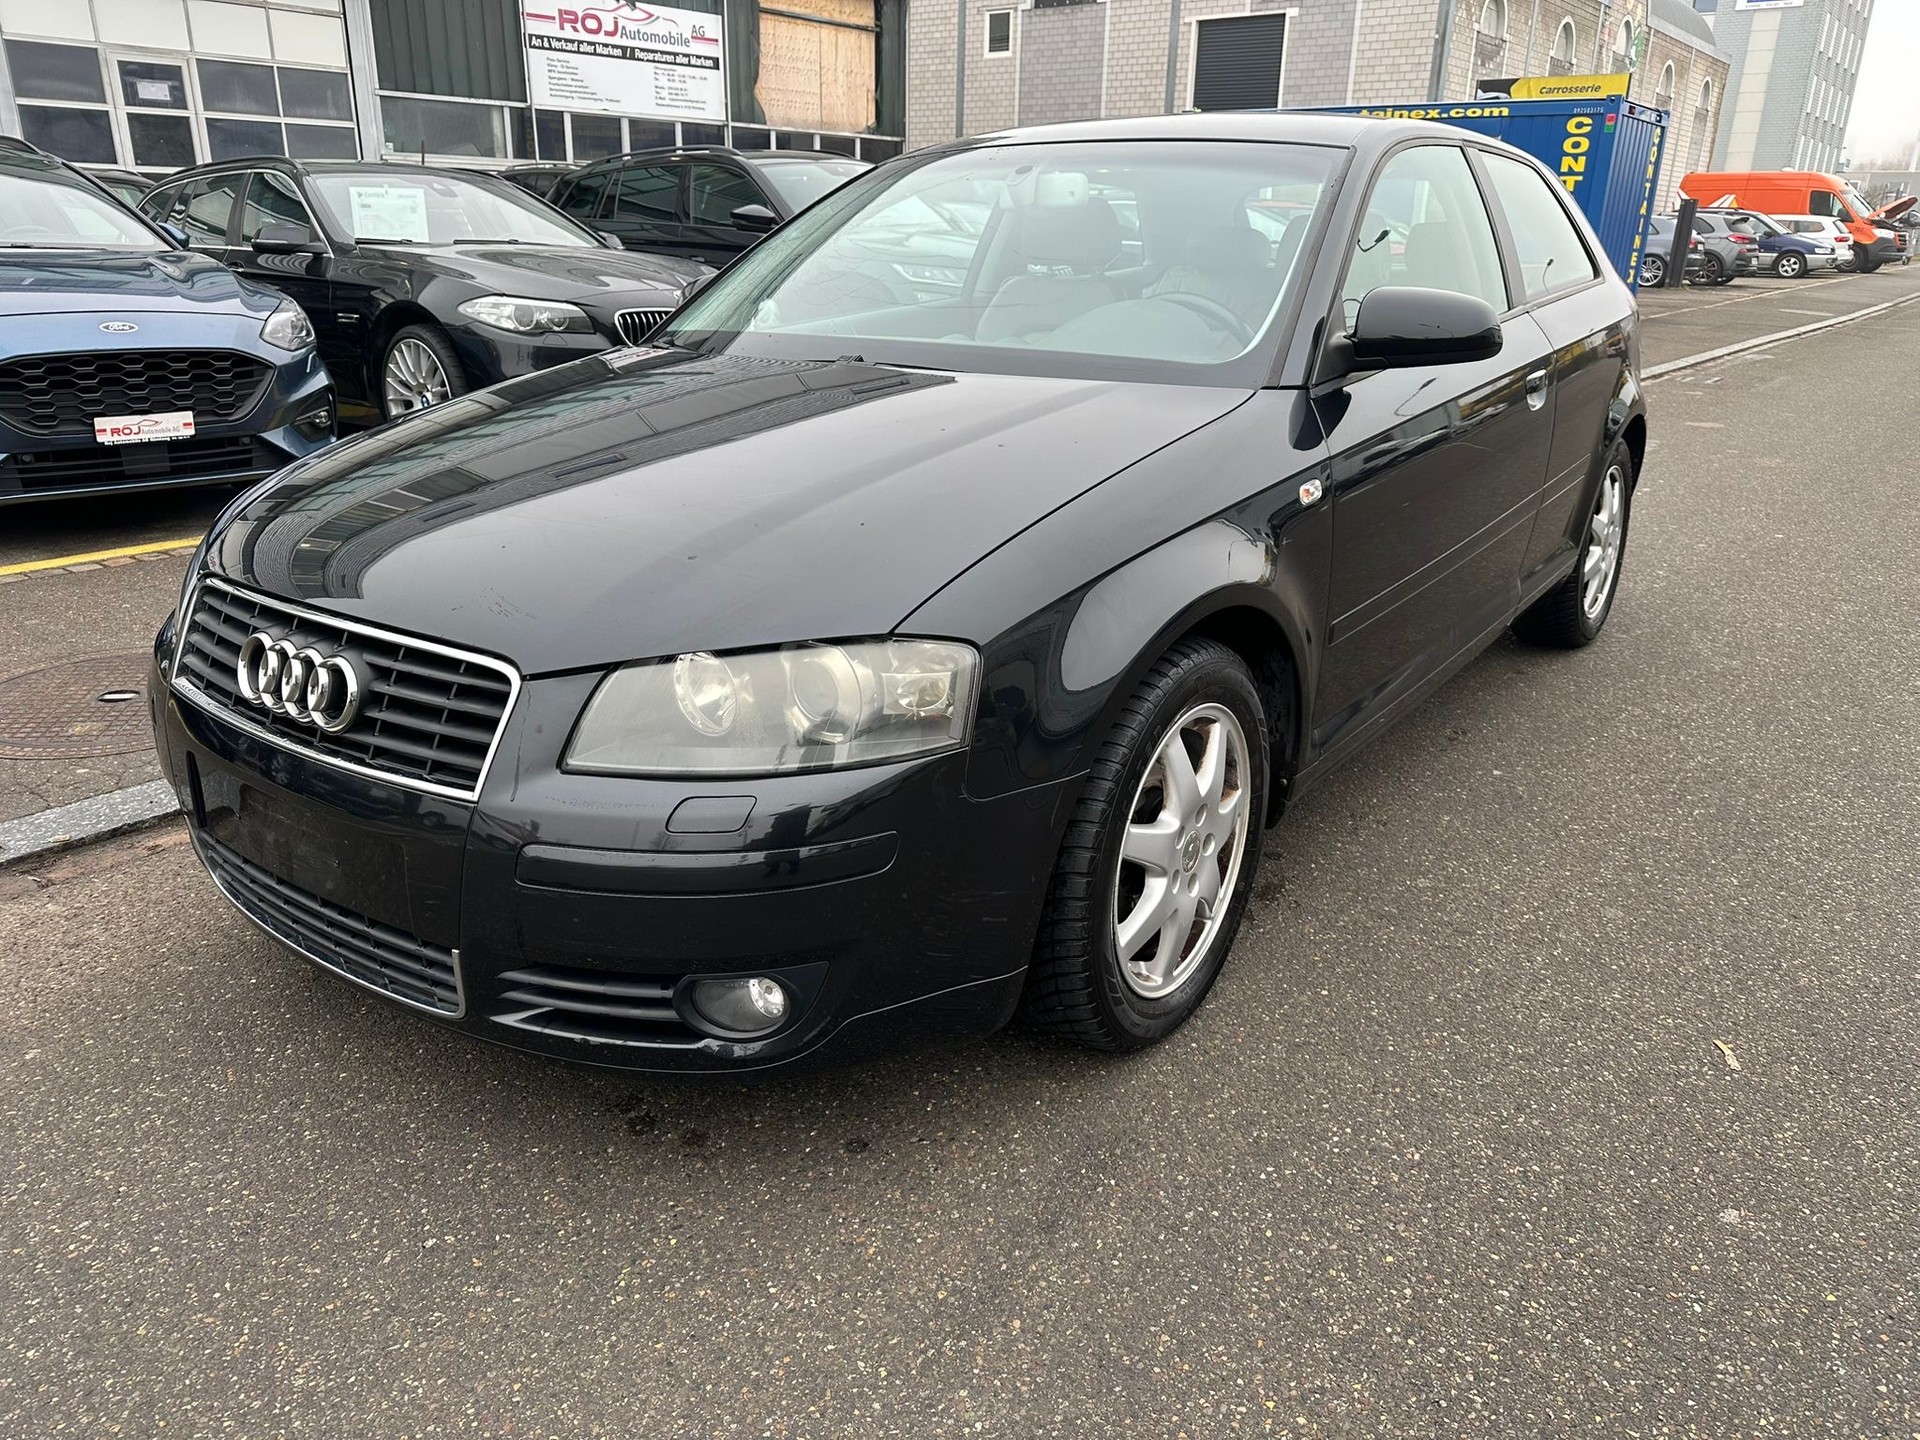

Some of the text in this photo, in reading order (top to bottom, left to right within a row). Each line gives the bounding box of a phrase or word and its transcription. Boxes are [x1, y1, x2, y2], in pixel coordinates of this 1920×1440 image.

[558, 8, 705, 47] ROJ Automobile AG
[531, 35, 542, 47] An
[543, 37, 550, 48] &
[550, 36, 578, 51] Verkauf
[579, 42, 595, 53] aller
[595, 44, 622, 57] Marken
[634, 48, 675, 63] Reparaturen
[676, 54, 689, 65] aller
[690, 55, 713, 67] Marken
[1539, 84, 1601, 94] Carrosserie
[1360, 106, 1509, 119] tainex.com
[1559, 116, 1593, 192] CONT
[1627, 126, 1661, 283] CONTAINEX
[110, 426, 141, 436] ROJ
